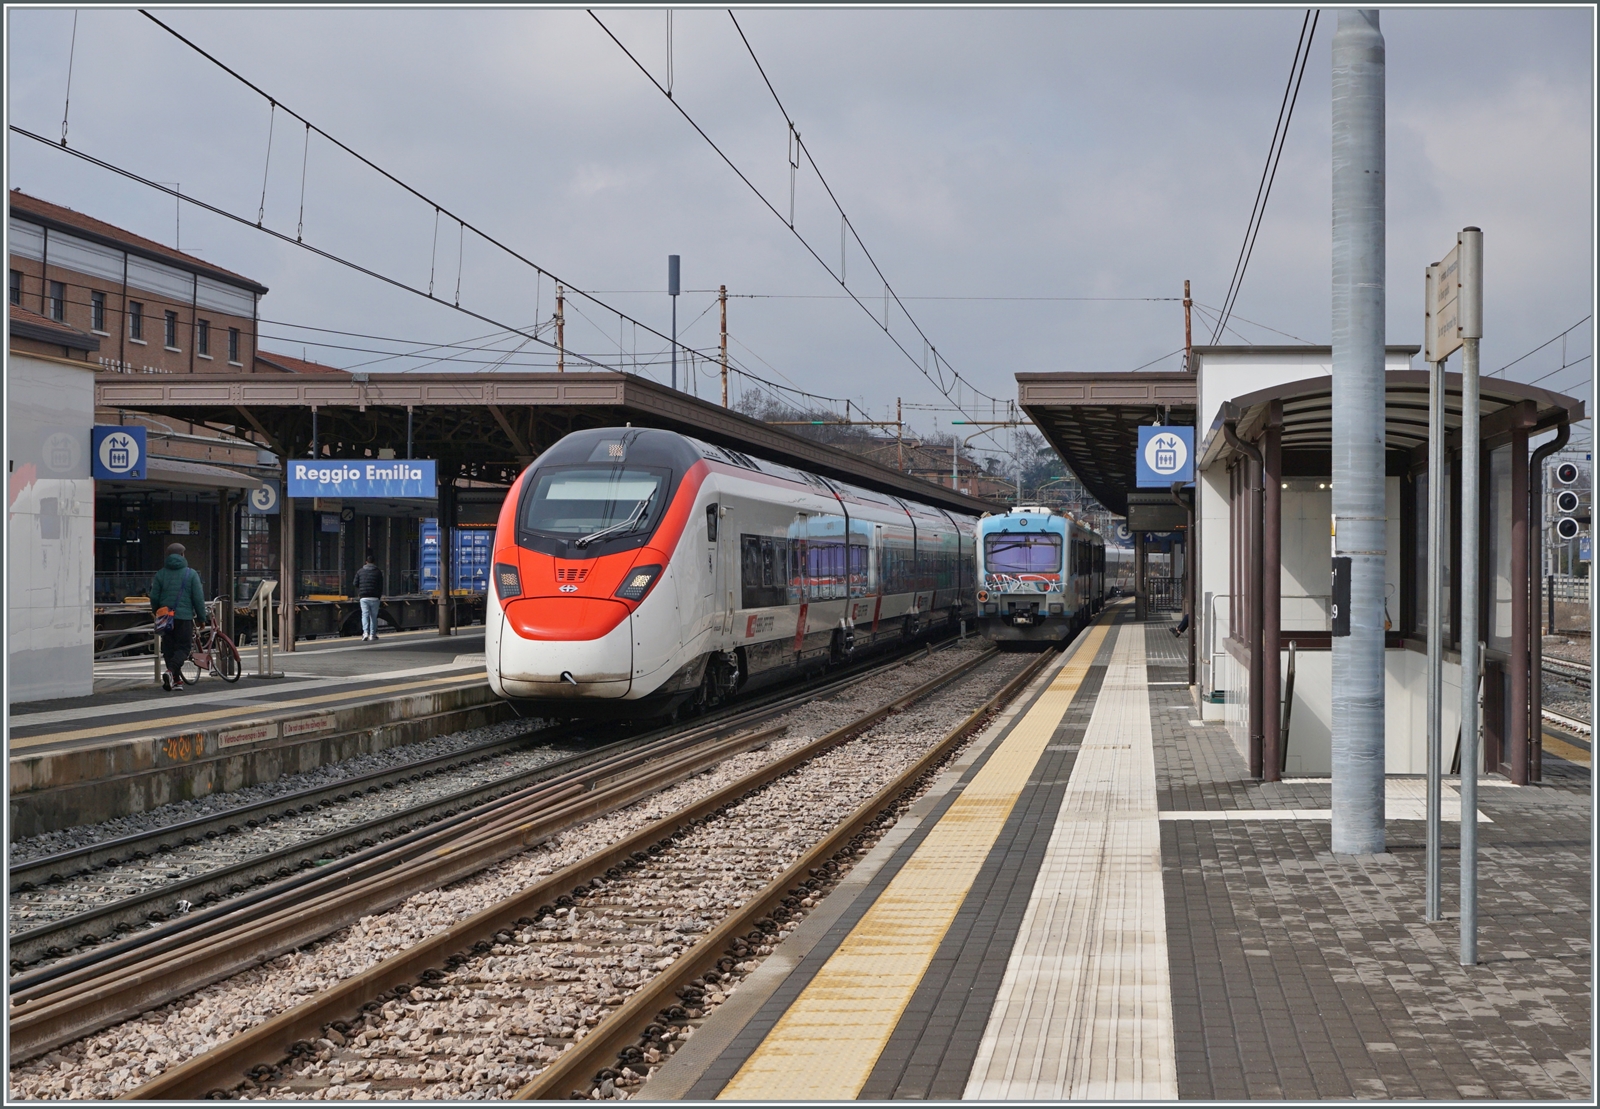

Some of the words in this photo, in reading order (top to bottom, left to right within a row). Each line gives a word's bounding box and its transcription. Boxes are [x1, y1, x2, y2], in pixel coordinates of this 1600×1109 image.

[295, 465, 361, 484] Reggio
[366, 464, 422, 480] Emilia
[257, 488, 270, 506] 3
